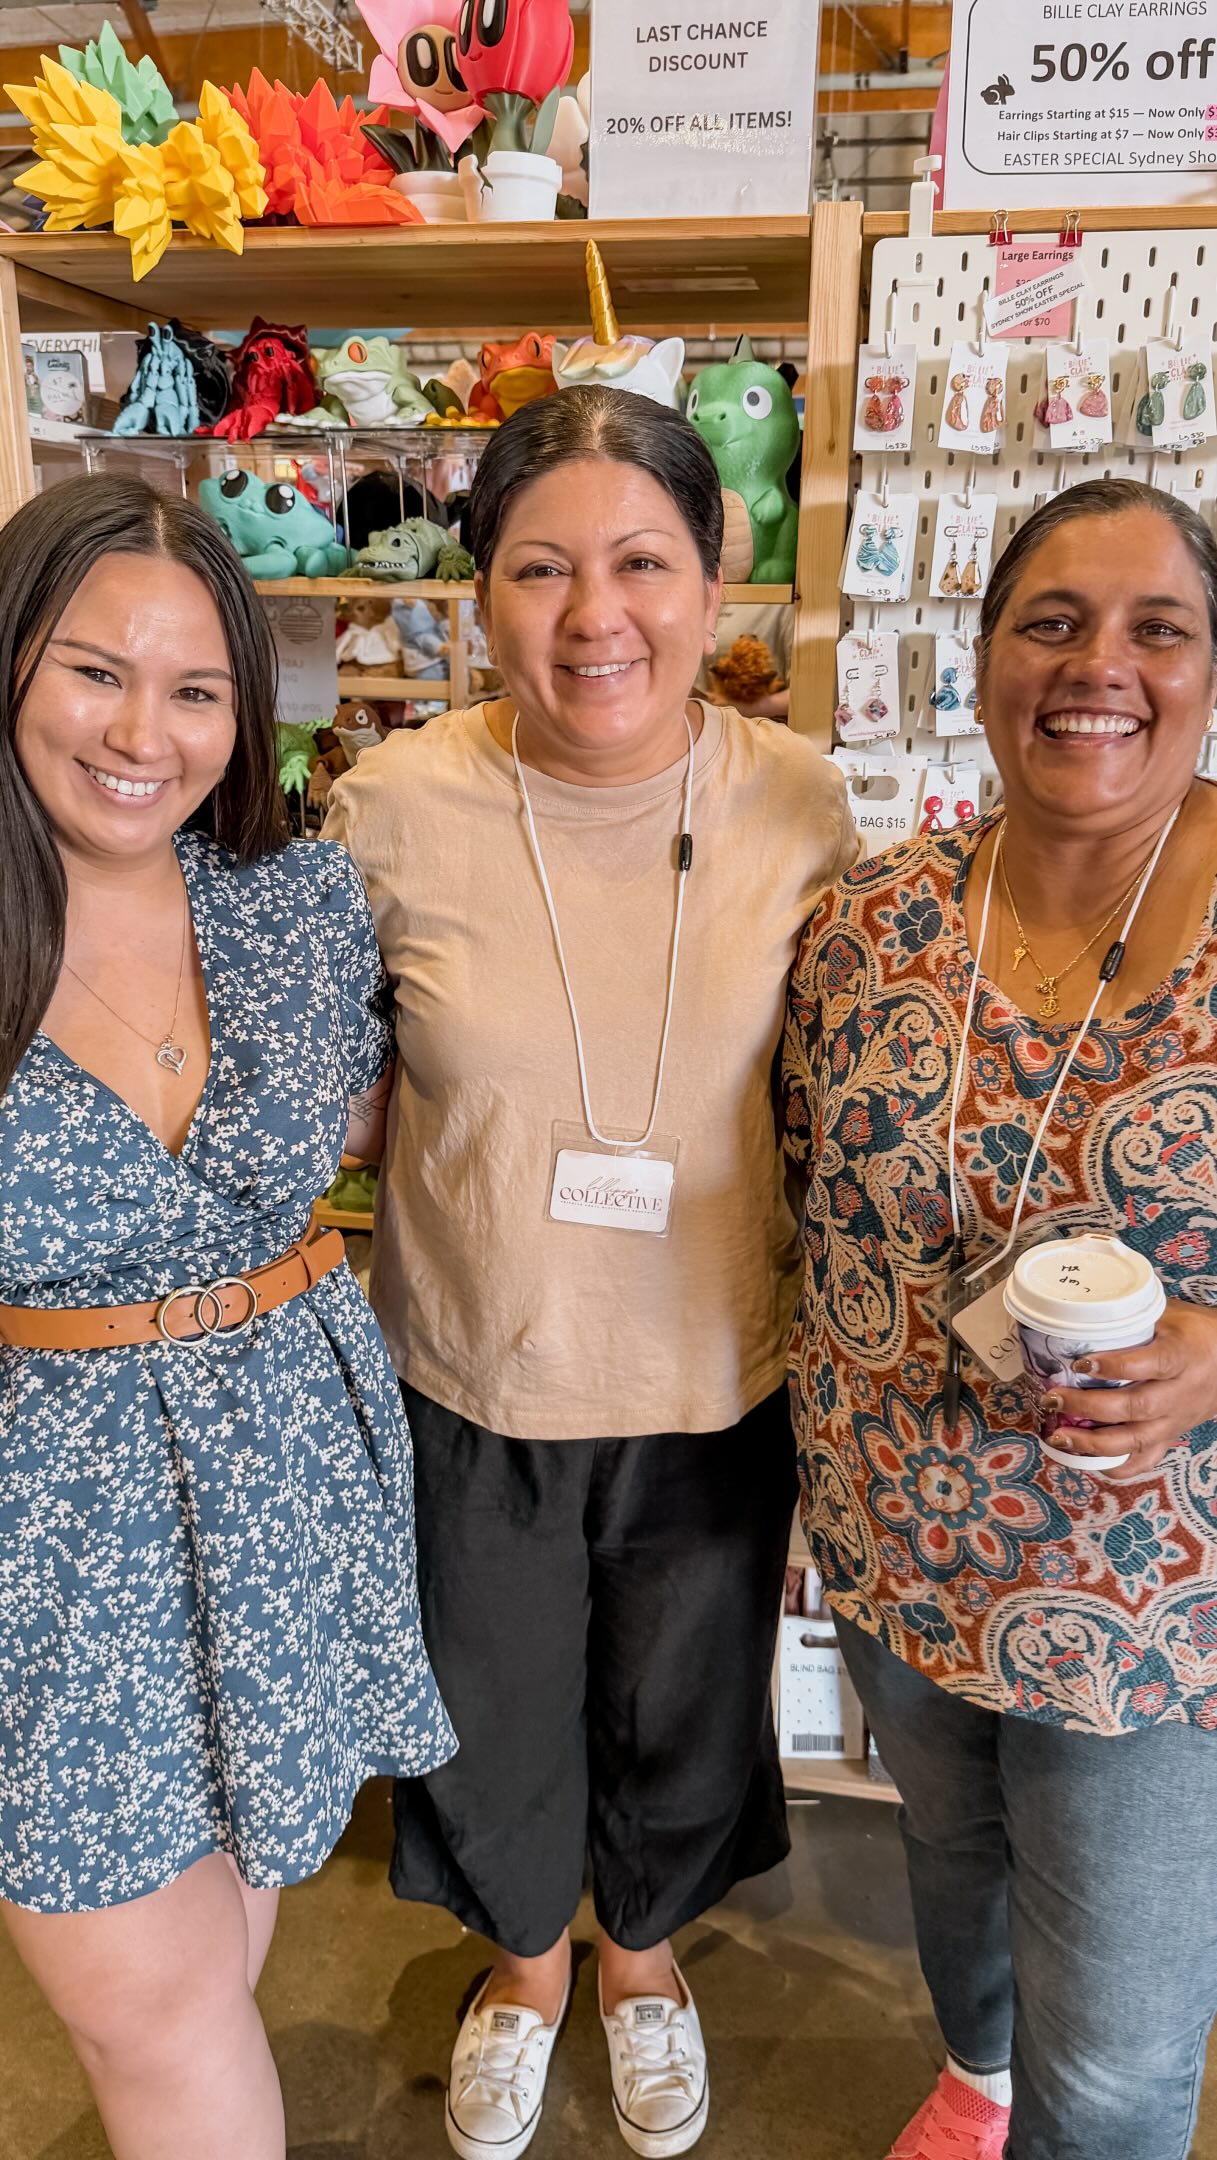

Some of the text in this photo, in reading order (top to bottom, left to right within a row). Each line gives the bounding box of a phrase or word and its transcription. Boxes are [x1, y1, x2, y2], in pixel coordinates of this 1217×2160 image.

[1043, 1, 1207, 19] BILLE CLAY EARRINGS
[636, 21, 768, 43] LAST CHANCE
[649, 52, 748, 72] DISCOUNT
[1030, 37, 1217, 83] 50% off
[606, 111, 792, 134] 20% OFF ALL ITEMS!
[998, 109, 1044, 122] Earrings
[1046, 108, 1091, 121] Starting
[1095, 109, 1106, 119] at
[1108, 107, 1129, 119] $15
[1148, 108, 1175, 118] Now
[1178, 107, 1205, 119] Only
[997, 130, 1020, 141] Hair
[1023, 130, 1050, 143] Clips
[1053, 129, 1097, 142] Starting
[1101, 130, 1112, 140] at
[1115, 128, 1129, 140] $7
[1148, 129, 1174, 139] Now
[1177, 128, 1204, 140] Only
[1004, 153, 1059, 166] EASTER
[1064, 152, 1125, 166] SPECIAL
[1129, 151, 1184, 167] Sydney
[1002, 250, 1074, 262] Large Earrings
[998, 291, 1015, 306] BILLE
[1016, 286, 1033, 299] CLAY
[1033, 272, 1065, 290] EARRINGS
[1015, 285, 1054, 309] 50% OFF
[991, 282, 1085, 330] SYDNEY SHOW EASTER SPECIAL
[1020, 318, 1050, 327] or $70
[860, 816, 884, 828] BAG
[887, 816, 906, 829] $15
[560, 1187, 663, 1212] COLLECTIVE
